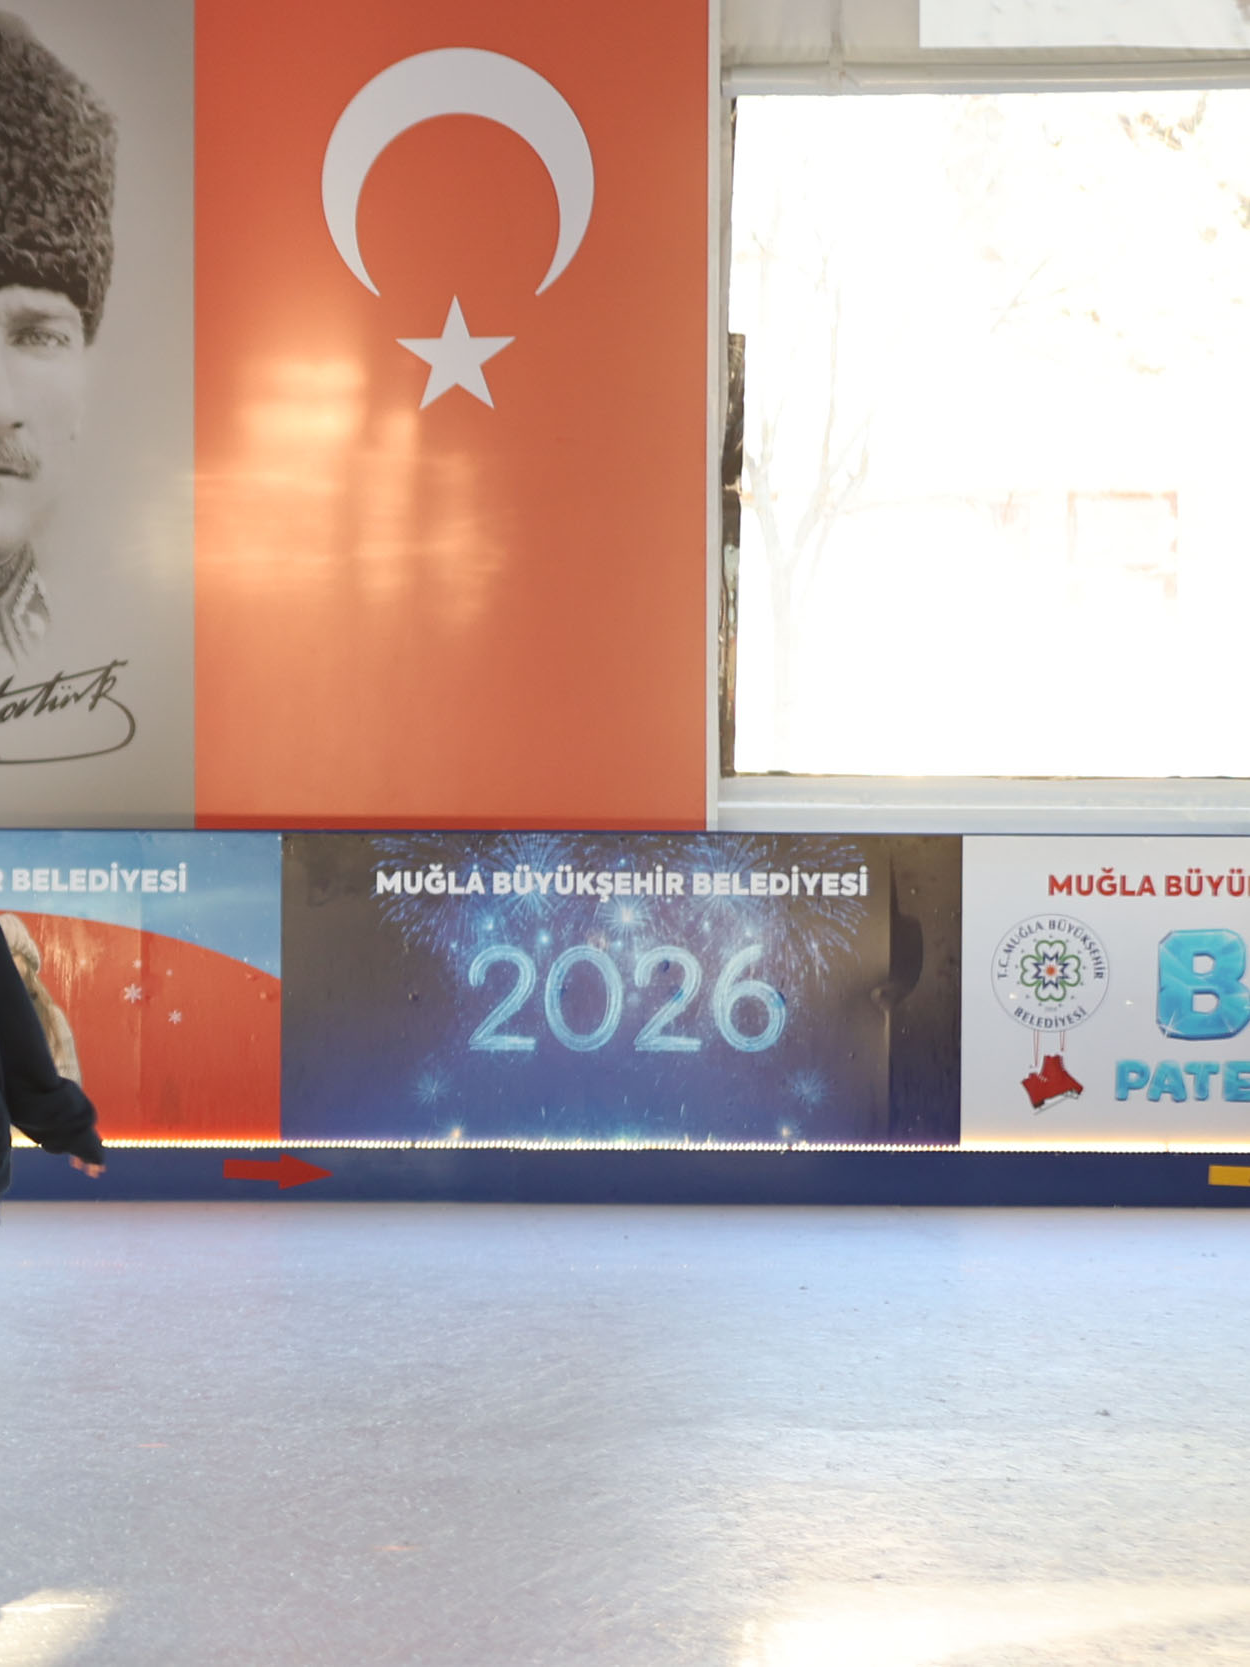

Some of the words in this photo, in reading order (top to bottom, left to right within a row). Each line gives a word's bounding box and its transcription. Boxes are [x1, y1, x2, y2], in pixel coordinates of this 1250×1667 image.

[12, 861, 187, 893] BELEDİYESİ
[375, 864, 485, 895] MUĞLA
[492, 864, 684, 902] BÜYÜKŞEHİR
[693, 865, 868, 897] BELEDİYESİ
[1048, 867, 1156, 897] MUĞLA
[1164, 867, 1250, 897] BÜYÜ
[1002, 920, 1045, 954] MUĞLA
[468, 944, 787, 1053] 2026
[1013, 1005, 1087, 1029] BELEDİYESİ
